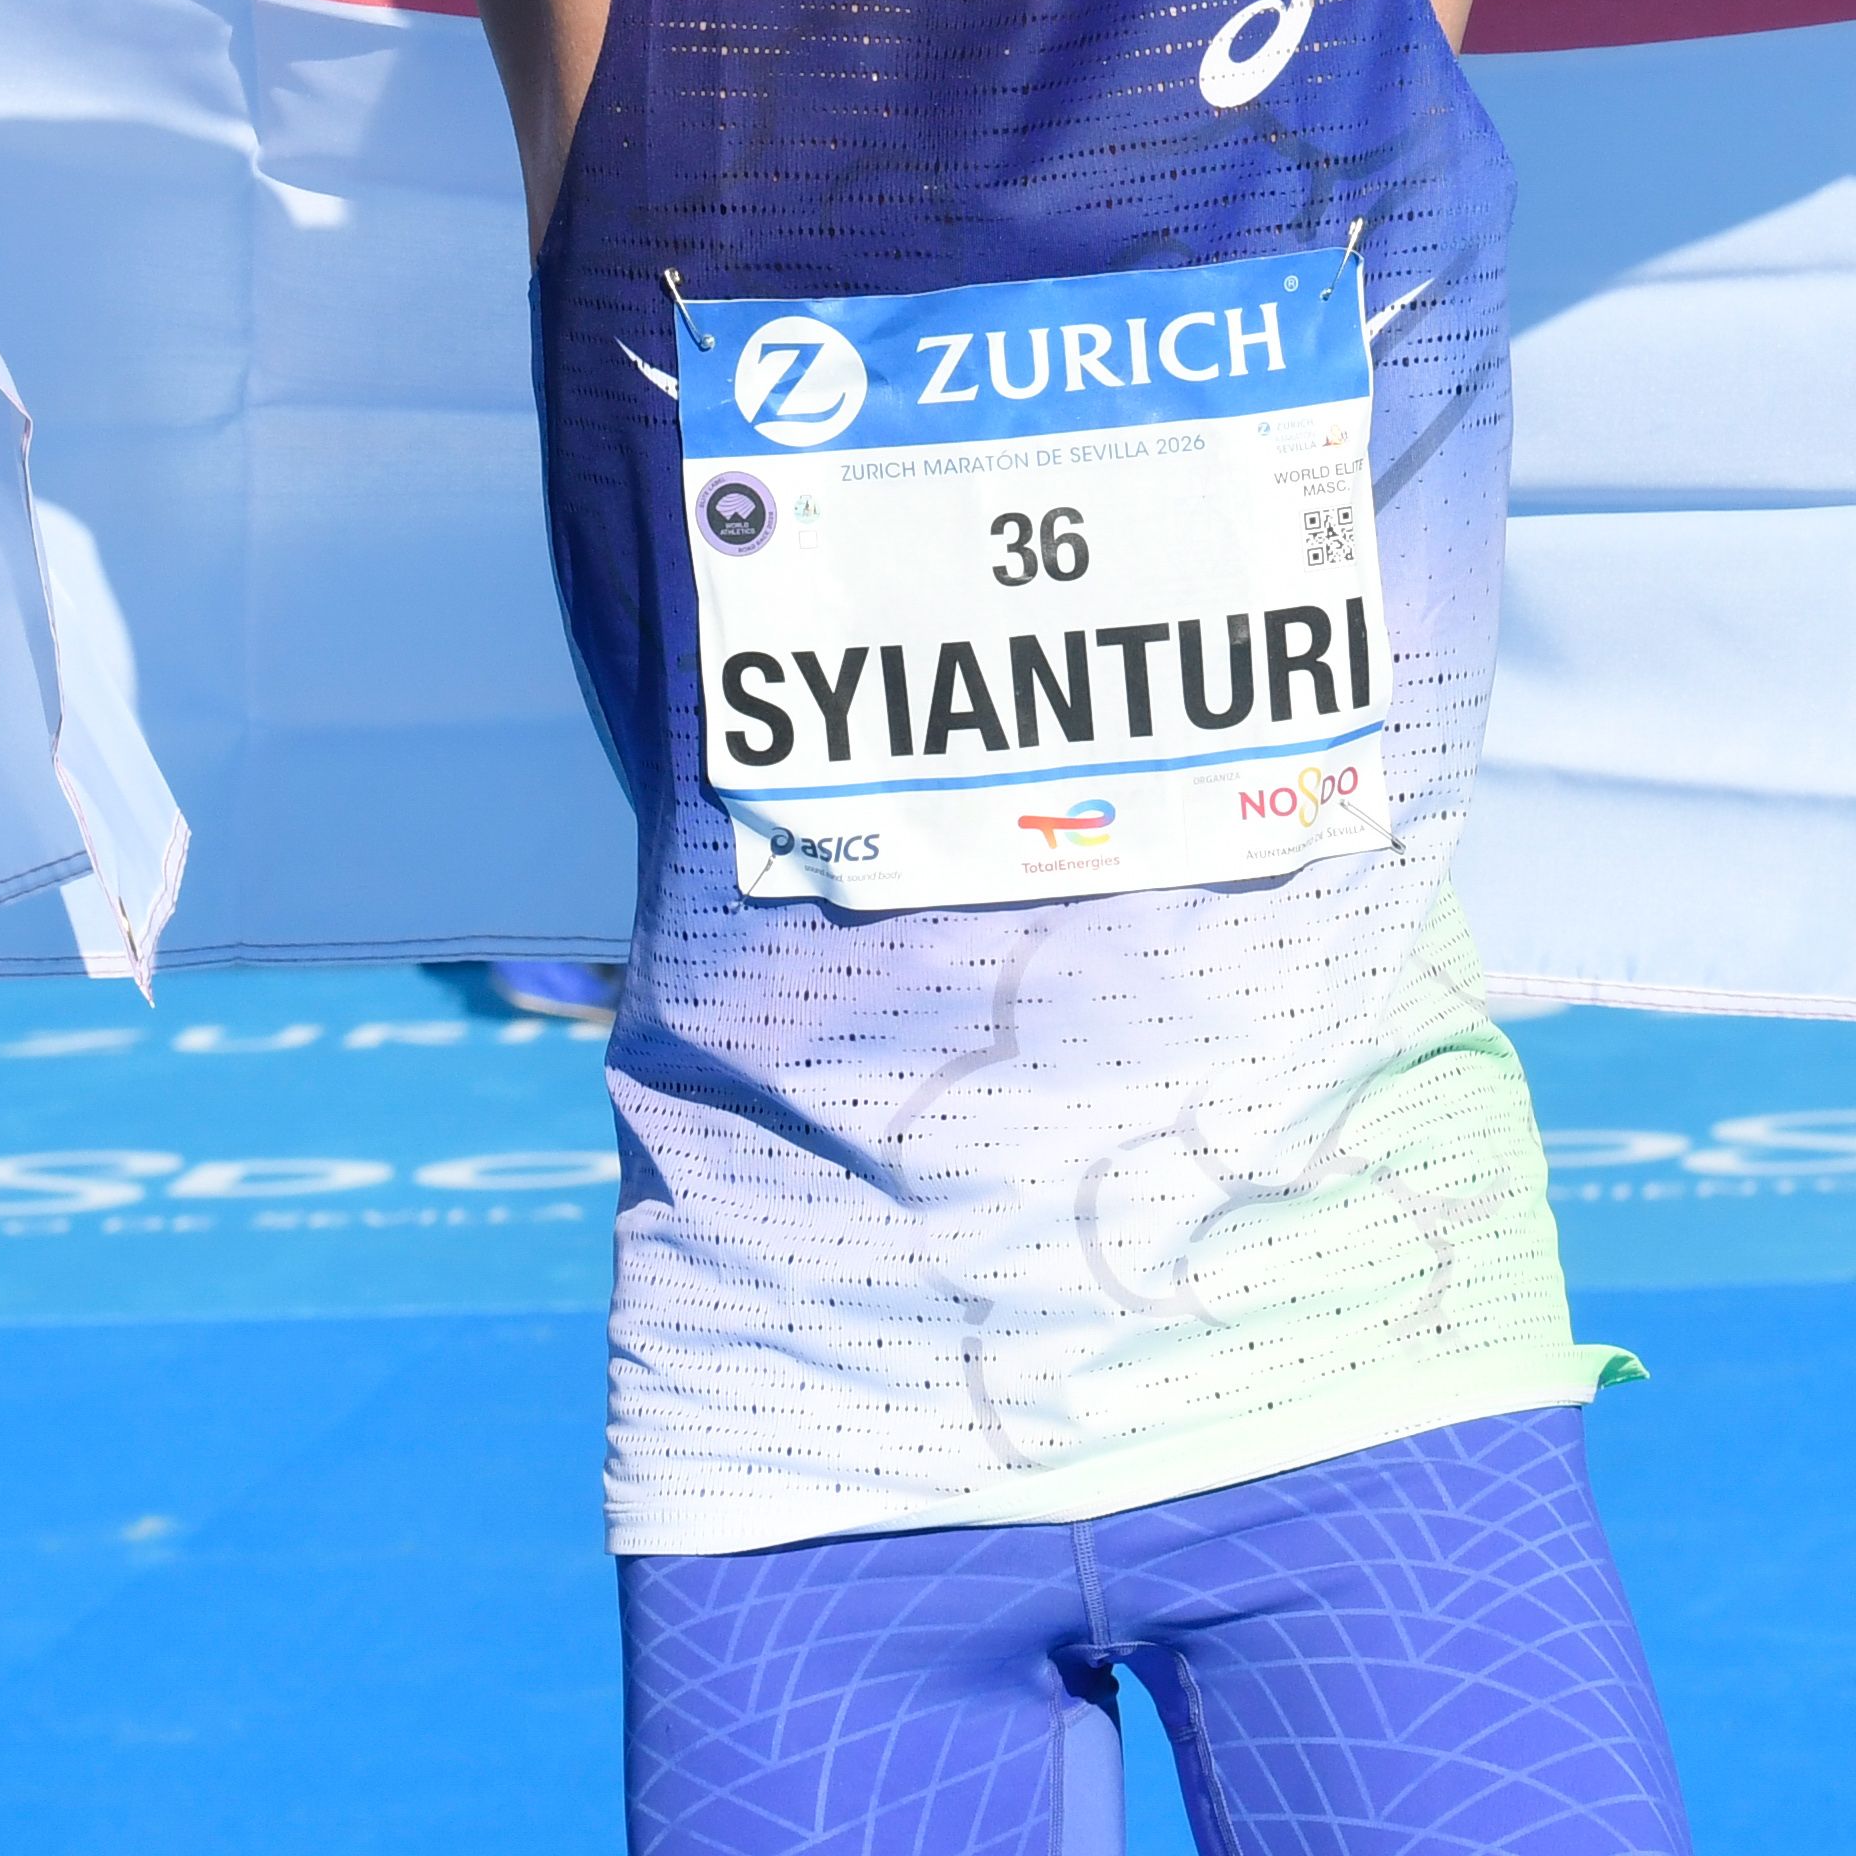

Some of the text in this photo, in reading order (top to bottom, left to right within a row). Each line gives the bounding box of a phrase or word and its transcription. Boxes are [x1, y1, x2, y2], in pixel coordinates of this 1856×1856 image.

[915, 300, 1288, 406] ZURICH
[839, 434, 1207, 482] ZURICH MARATÓN DE SEVILLA 2026
[1273, 457, 1364, 485] WORLD ELITE
[1302, 479, 1351, 497] MASC.
[988, 505, 1091, 587] 36
[720, 596, 1372, 767] SYIANTURI
[1192, 771, 1242, 786] ORGANIZA
[1326, 824, 1366, 839] SEVILLA
[1021, 855, 1121, 875] TotalEnergies
